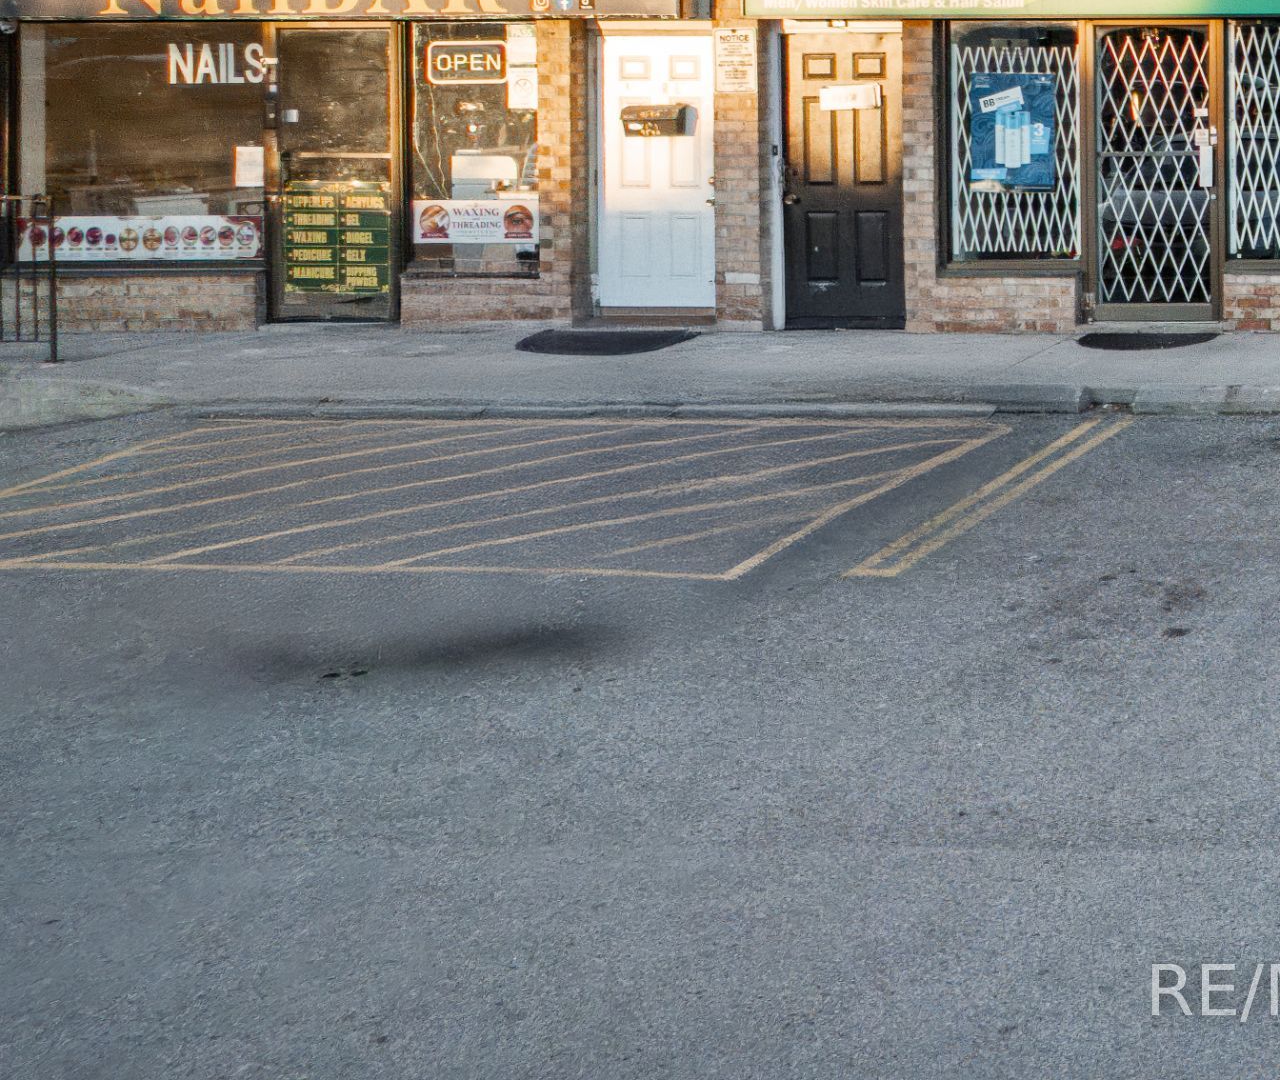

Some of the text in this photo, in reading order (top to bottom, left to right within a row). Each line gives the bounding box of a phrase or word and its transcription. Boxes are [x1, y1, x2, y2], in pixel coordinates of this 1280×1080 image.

[168, 43, 264, 84] NAILS
[436, 53, 501, 71] OPEN
[982, 98, 996, 108] BB
[1034, 123, 1044, 136] 3
[453, 207, 500, 217] WAXING
[452, 221, 501, 229] THREADING
